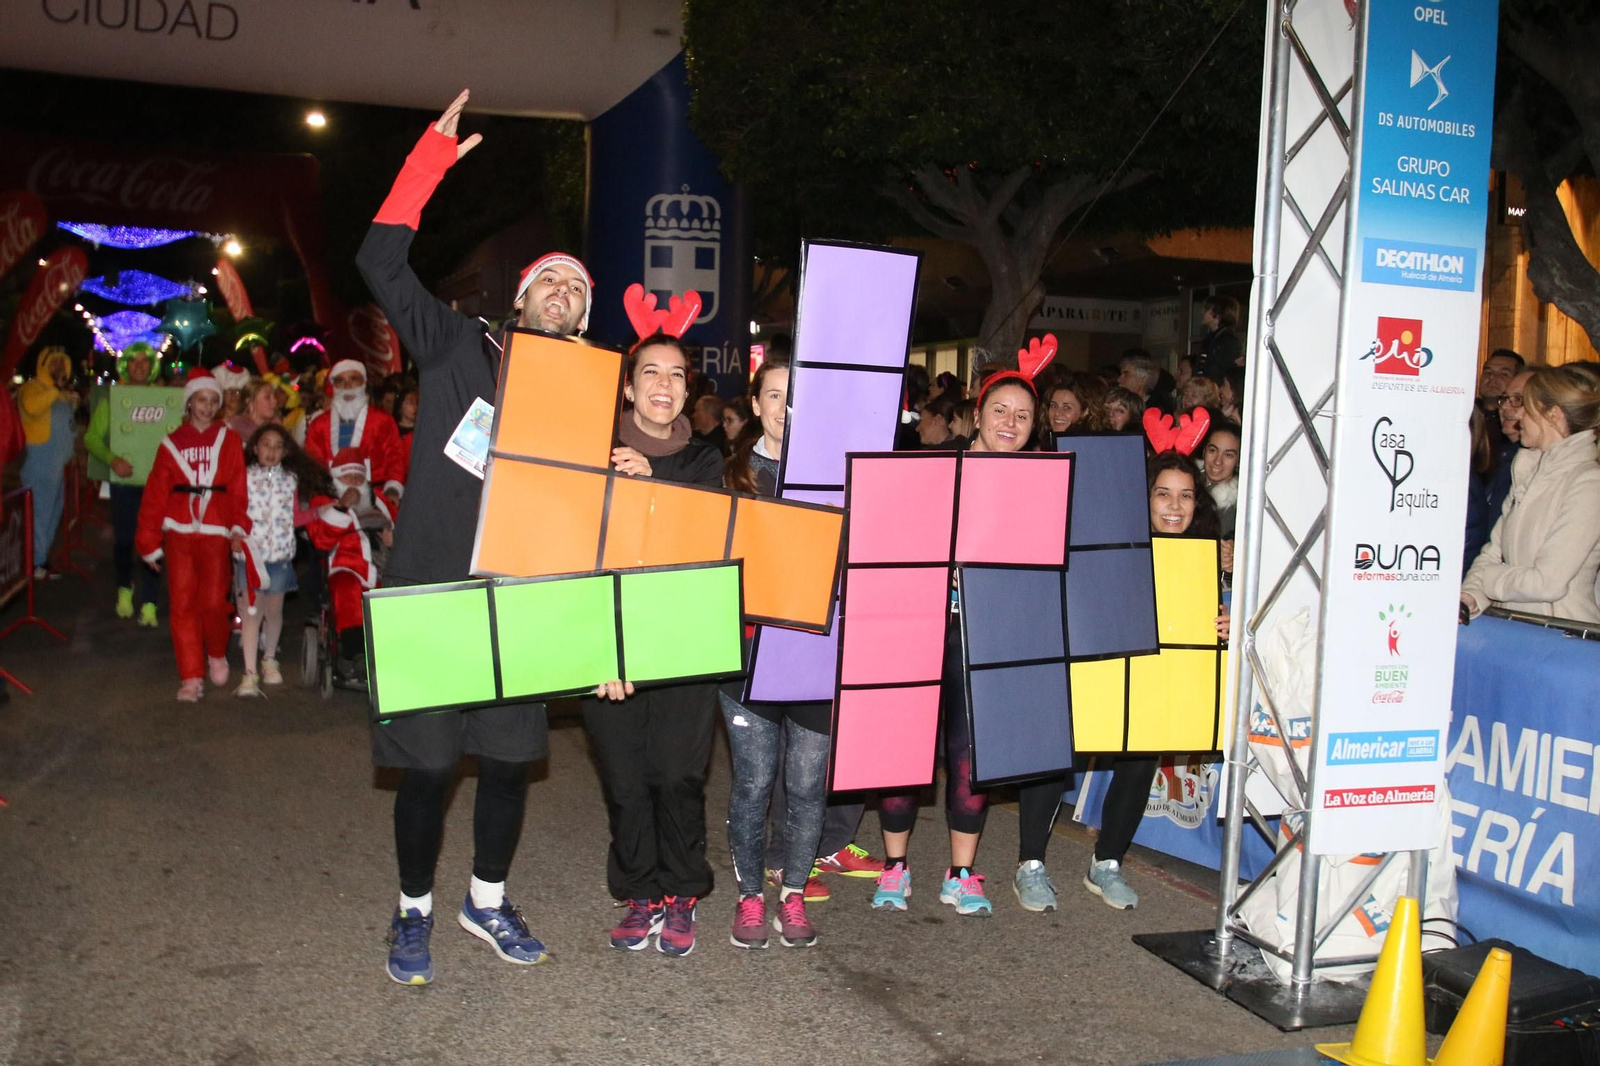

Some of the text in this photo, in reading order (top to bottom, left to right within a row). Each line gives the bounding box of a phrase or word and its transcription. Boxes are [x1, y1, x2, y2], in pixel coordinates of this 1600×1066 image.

[43, 0, 240, 41] CIUDAD
[1414, 6, 1448, 26] OPEL
[1378, 112, 1476, 138] DS AUTOMOBILES
[1397, 156, 1450, 177] GRUPO
[1372, 177, 1470, 204] SALINAS CAR
[1376, 248, 1464, 274] DECATHLON
[1427, 273, 1437, 281] de
[1371, 382, 1415, 392] DEPORTES
[1417, 384, 1429, 393] DE
[131, 405, 165, 422] LEGO
[1390, 450, 1439, 516] Paquita
[1354, 543, 1441, 571] DUNA
[1353, 571, 1440, 582] reformasduna.com
[1375, 670, 1408, 682] BUEN
[1330, 737, 1405, 760] Almericar
[1324, 788, 1435, 807] La Voz de Almería
